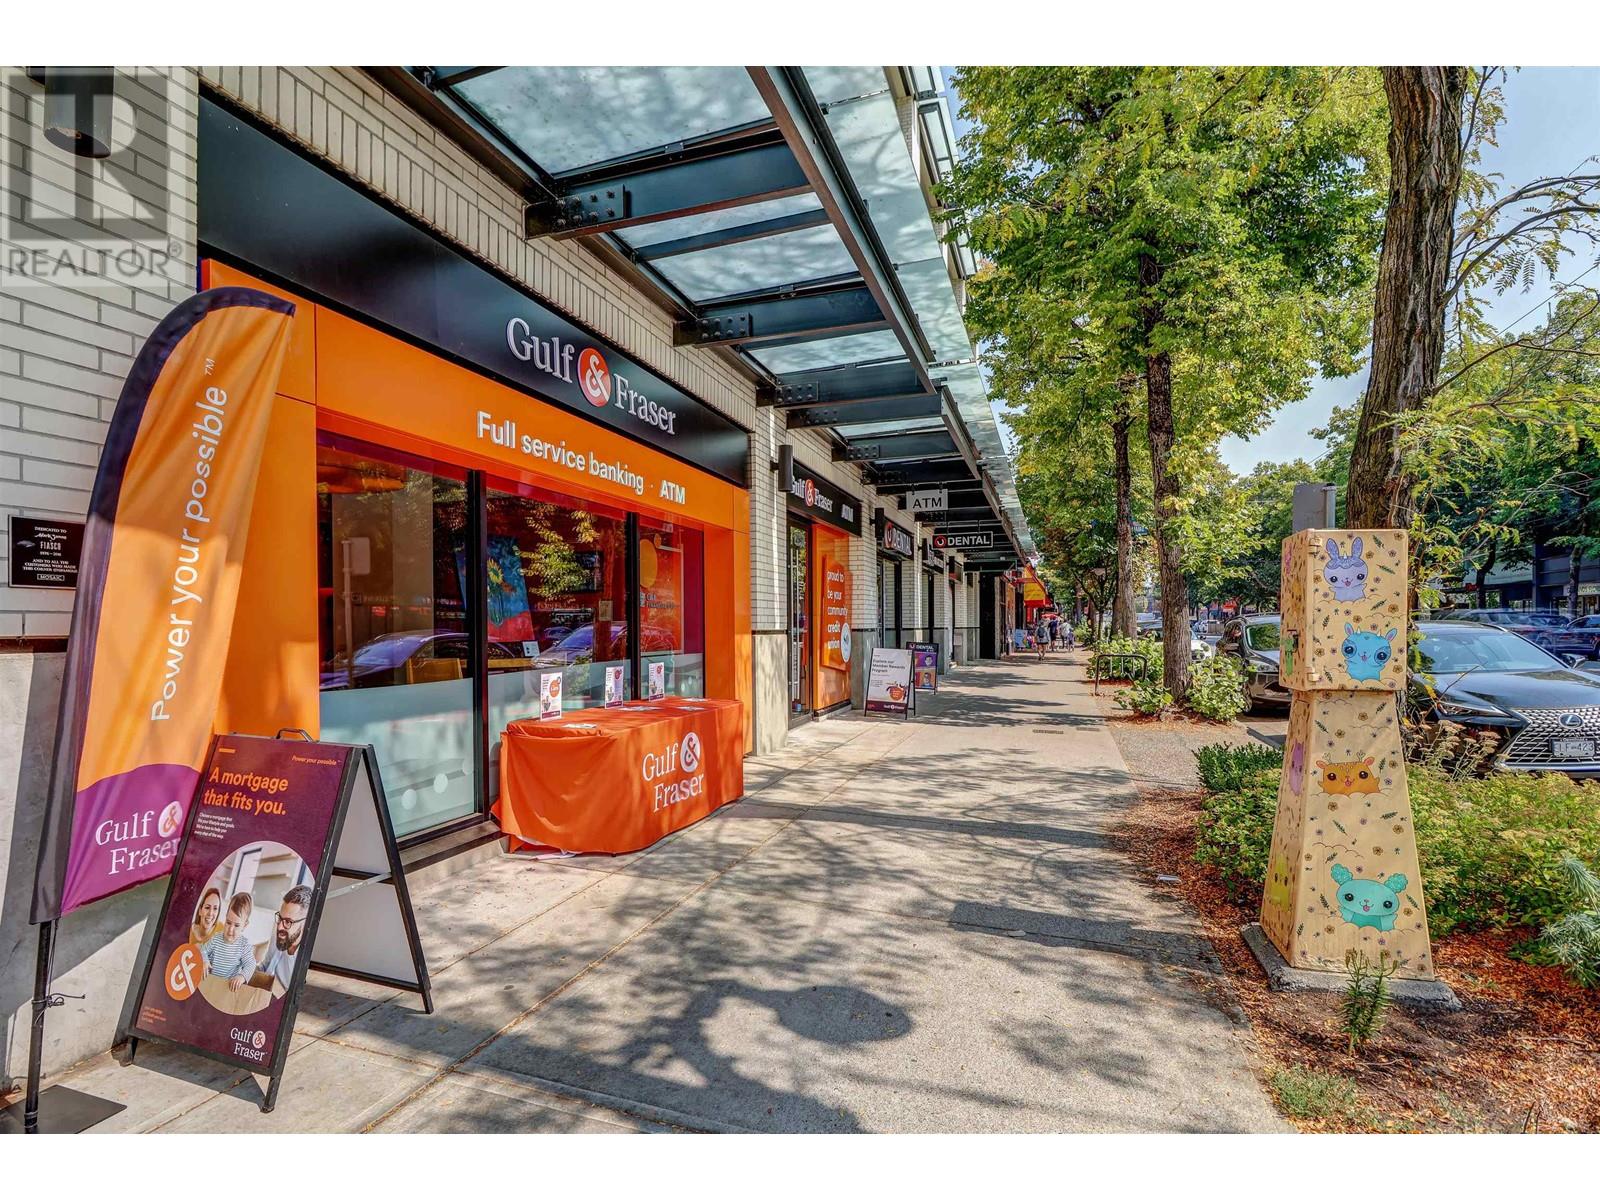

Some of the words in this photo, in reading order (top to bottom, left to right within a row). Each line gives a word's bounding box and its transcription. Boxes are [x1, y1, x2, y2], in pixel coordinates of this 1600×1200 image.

[505, 316, 575, 384] Gulf
[613, 372, 677, 435] Fraser
[185, 386, 229, 523] possible
[476, 410, 517, 449] Full
[520, 434, 586, 472] service
[588, 451, 645, 496] banking
[658, 479, 686, 505] ATM
[912, 497, 942, 509] ATM
[40, 541, 62, 550] FIASCO
[947, 535, 990, 547] DENTAL
[171, 528, 203, 605] your
[151, 613, 193, 721] Power
[642, 742, 678, 782] Gulf
[209, 767, 220, 783] A
[220, 772, 289, 795] mortgage
[653, 772, 705, 813] Fraser
[203, 788, 230, 808] that
[231, 793, 253, 811] fits
[253, 801, 287, 817] you.
[95, 810, 155, 846] Gulf
[108, 837, 181, 876] Fraser
[230, 1027, 253, 1042] Gulf
[233, 1042, 265, 1062] Fraser
